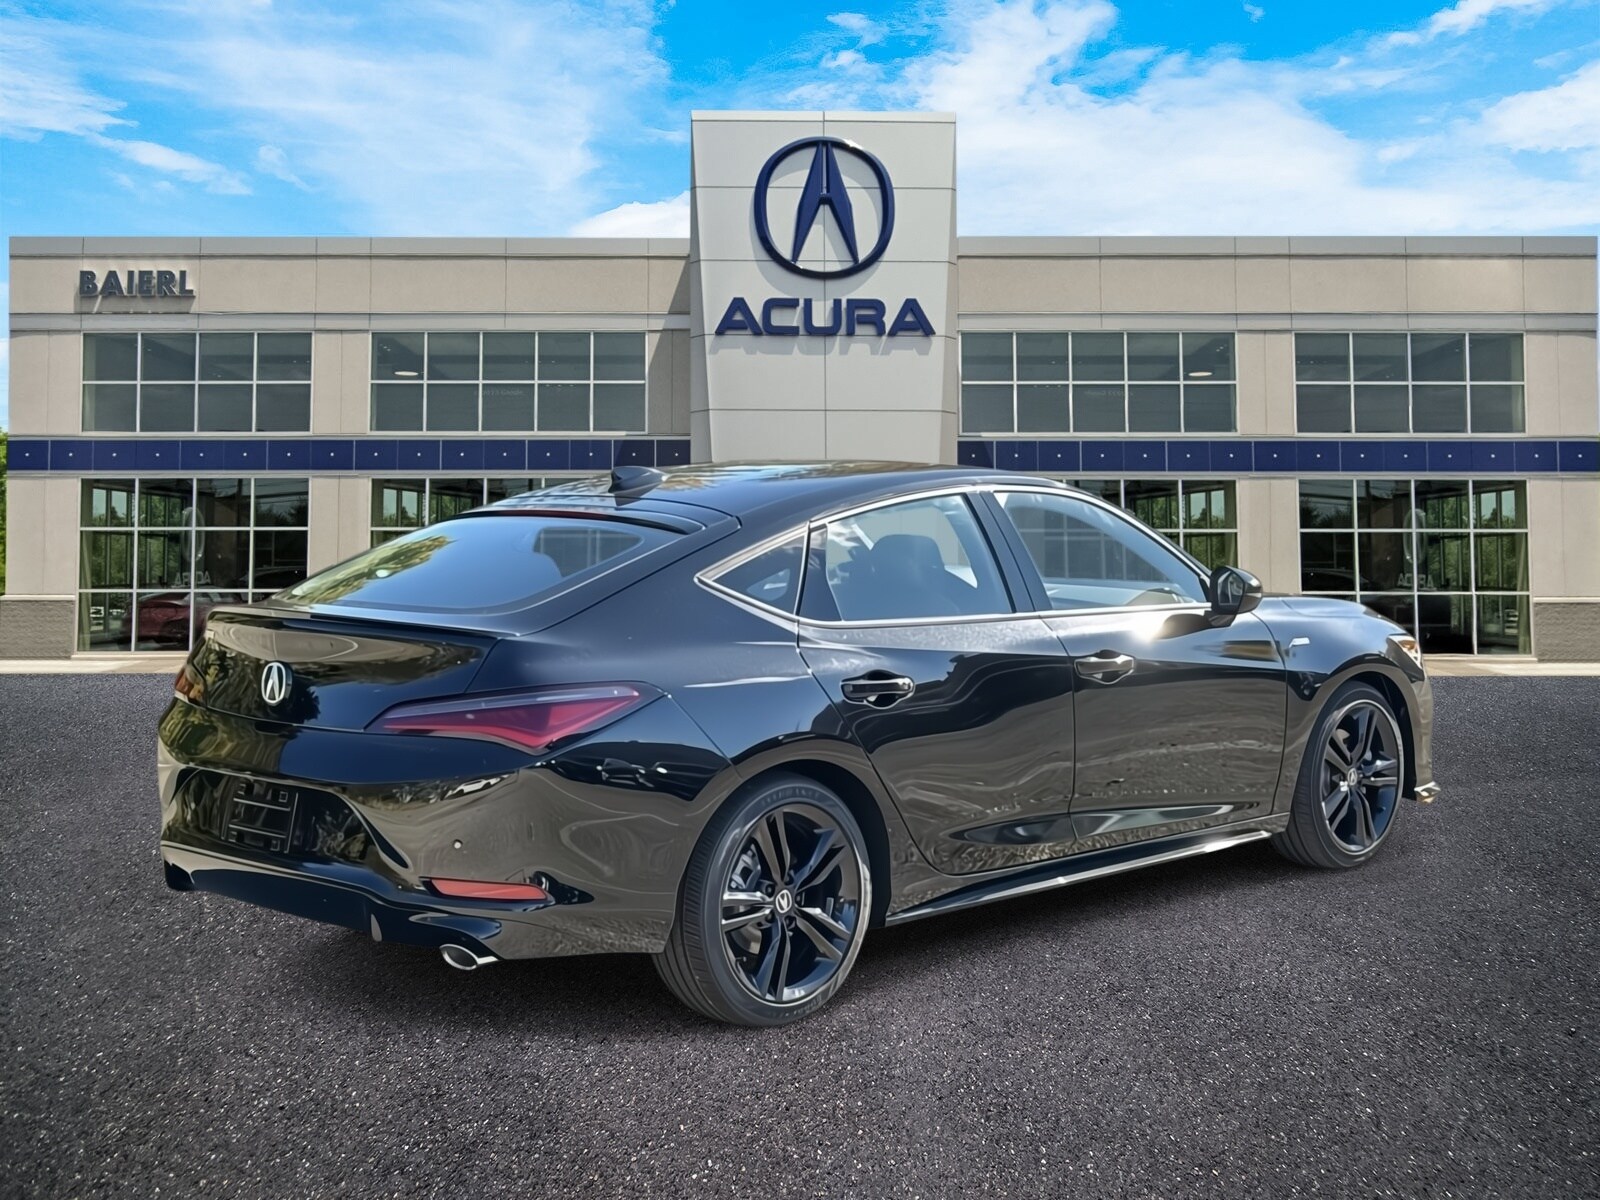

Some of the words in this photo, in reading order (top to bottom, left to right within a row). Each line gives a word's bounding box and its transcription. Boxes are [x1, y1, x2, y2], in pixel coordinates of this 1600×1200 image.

[79, 269, 195, 297] BAIERL
[715, 297, 936, 336] ACURA
[1396, 573, 1435, 588] ACRA
